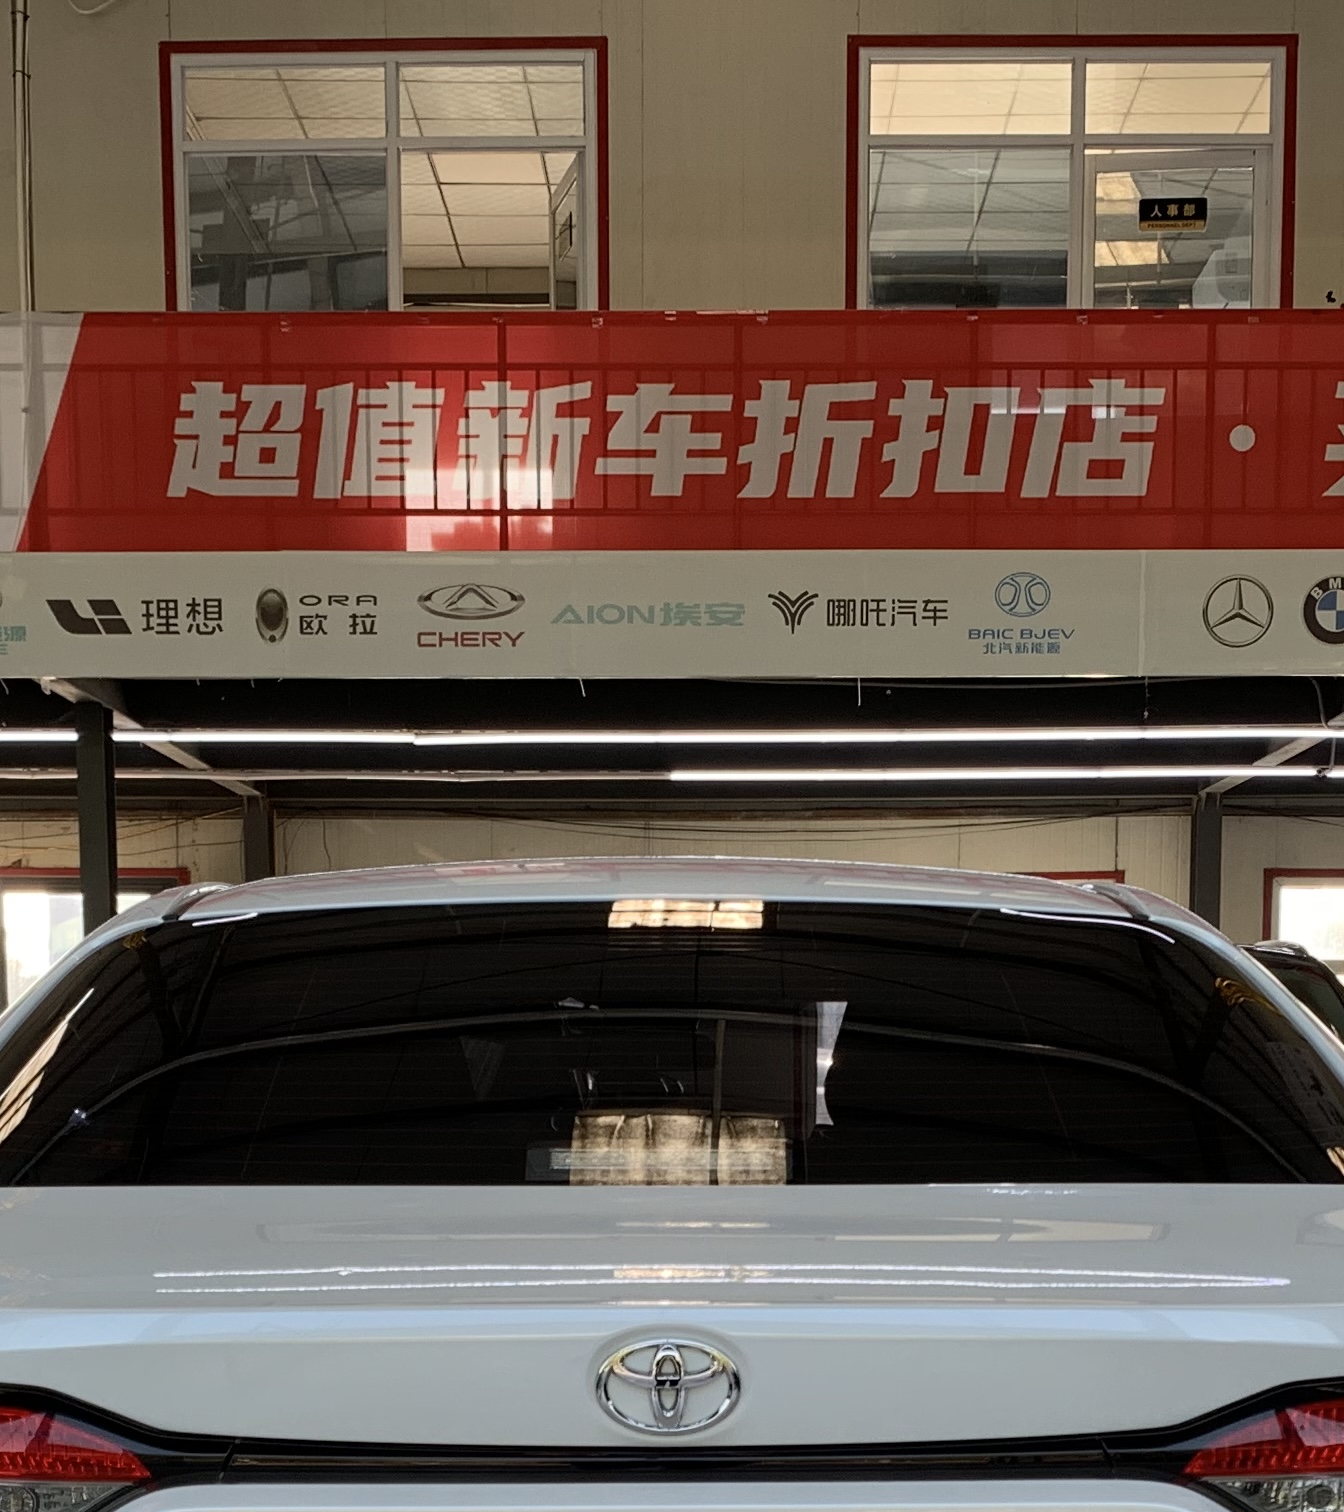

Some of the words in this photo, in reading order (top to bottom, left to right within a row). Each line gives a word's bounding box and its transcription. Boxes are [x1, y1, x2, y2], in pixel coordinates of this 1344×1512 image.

[1150, 203, 1196, 218] 人事部
[166, 378, 1167, 501] 超值新车折扣店
[299, 595, 378, 606] ORA
[141, 598, 224, 635] 理想
[827, 599, 949, 627] 哪吒汽车
[299, 613, 378, 636] 欧拉
[417, 631, 526, 649] CHERY
[968, 628, 1014, 640] BAIC
[1019, 628, 1076, 640] BJEV
[982, 642, 1061, 655] 北汽新能源
